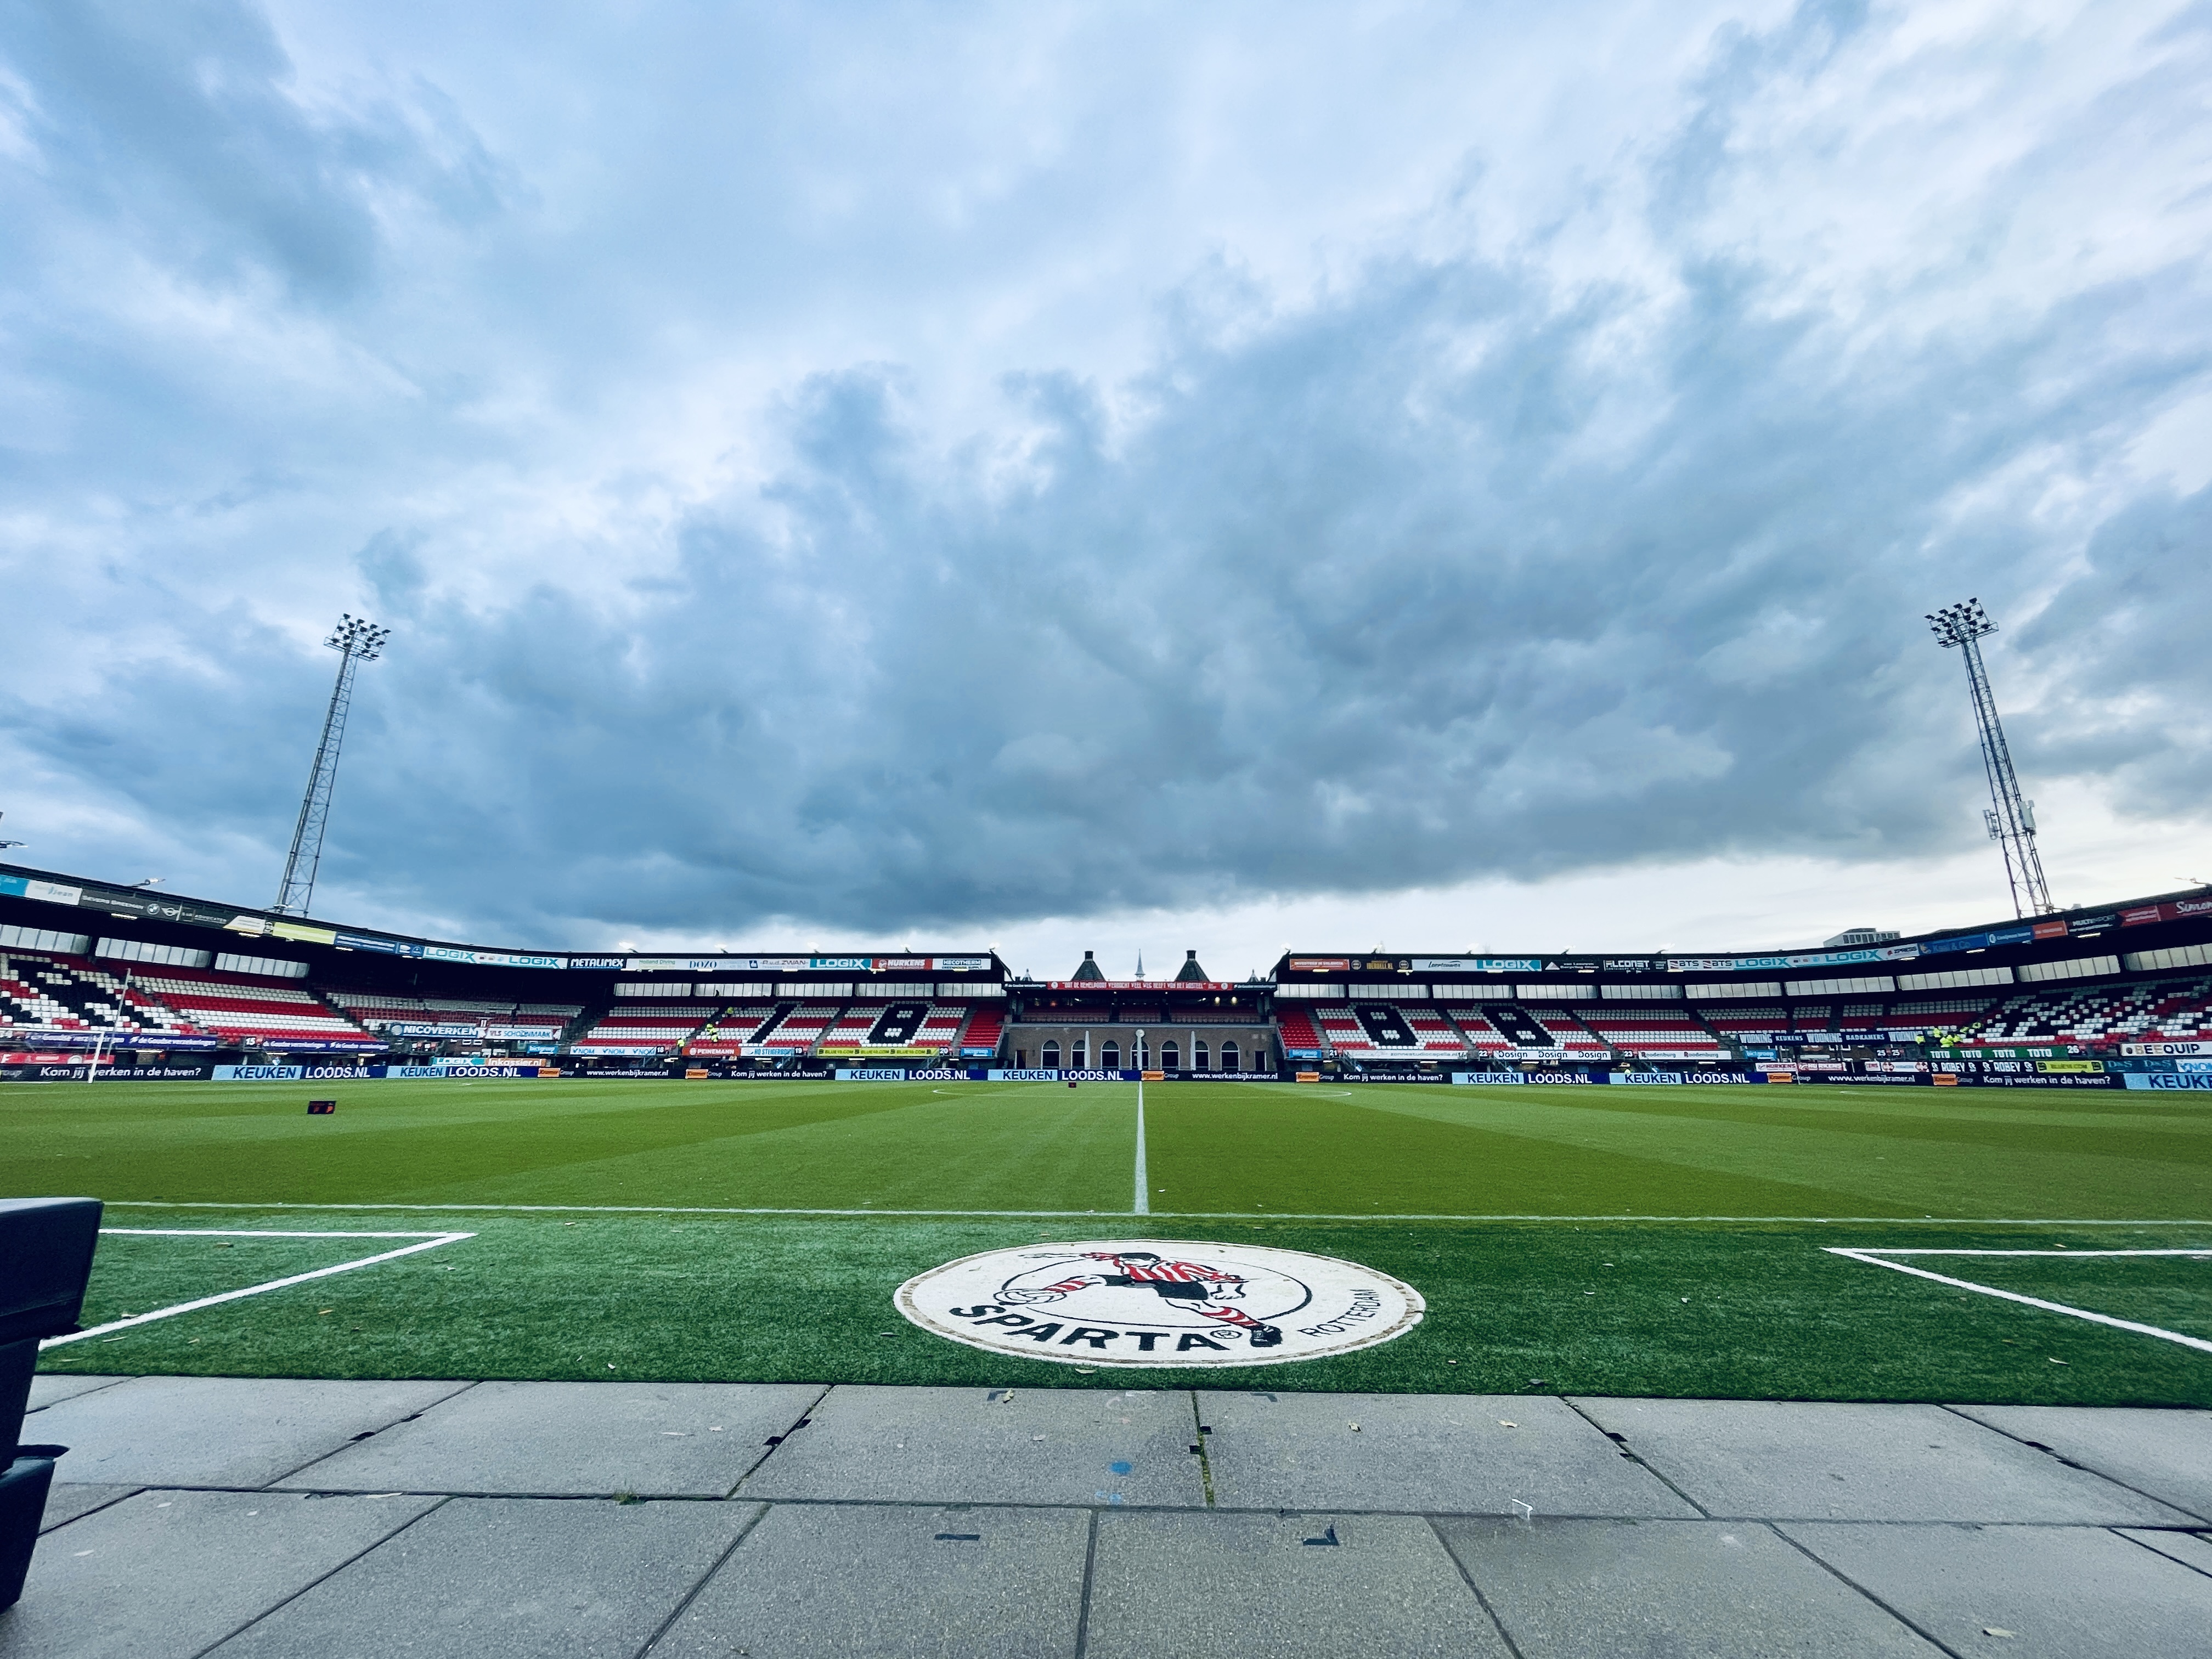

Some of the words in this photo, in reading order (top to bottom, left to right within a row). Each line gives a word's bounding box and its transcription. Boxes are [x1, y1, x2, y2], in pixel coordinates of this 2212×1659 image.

[426, 947, 476, 963] LOGIX
[1825, 950, 1884, 962] LOGIX
[509, 956, 560, 968] LOGIX
[816, 959, 866, 969] LOGIX
[1483, 961, 1534, 970] LOGIX
[1735, 957, 1792, 968] LOGIX
[403, 1025, 476, 1035] NICOVERKEN
[1993, 1049, 2016, 1058] TOTO
[2027, 1048, 2052, 1057] TOTO
[2135, 1043, 2200, 1054] BEEQUIP
[1960, 1050, 1982, 1058] TOTO
[40, 1066, 70, 1076] Kom
[72, 1066, 86, 1079] jij
[133, 1067, 143, 1076] in
[146, 1067, 161, 1076] de
[163, 1067, 201, 1076] haven?
[233, 1067, 297, 1079] KEUKEN
[305, 1066, 370, 1079] LOODS.NL
[400, 1067, 443, 1076] KEUKEN
[448, 1066, 521, 1077] LOODS.NL
[587, 1069, 669, 1077] www.werkenbijkramer.nl
[850, 1070, 900, 1079] KEUKEN
[909, 1070, 970, 1080] LOODS.NL
[1003, 1070, 1053, 1080] KEUKEN
[1062, 1070, 1124, 1080] LOODS.NL
[1468, 1074, 1519, 1083] KEUKEN
[1528, 1074, 1592, 1084] LOODS.NL
[1624, 1074, 1676, 1083] KEUKEN
[1685, 1074, 1750, 1084] LOODS.NL
[1828, 1074, 1915, 1083] www.werkenbijkramer.nl
[2004, 1075, 2013, 1085] jij
[2014, 1075, 2047, 1084] werken
[2074, 1076, 2111, 1084] haven?
[949, 1305, 1231, 1351] SPARTA
[1297, 1289, 1381, 1338] ROTTERDAM
